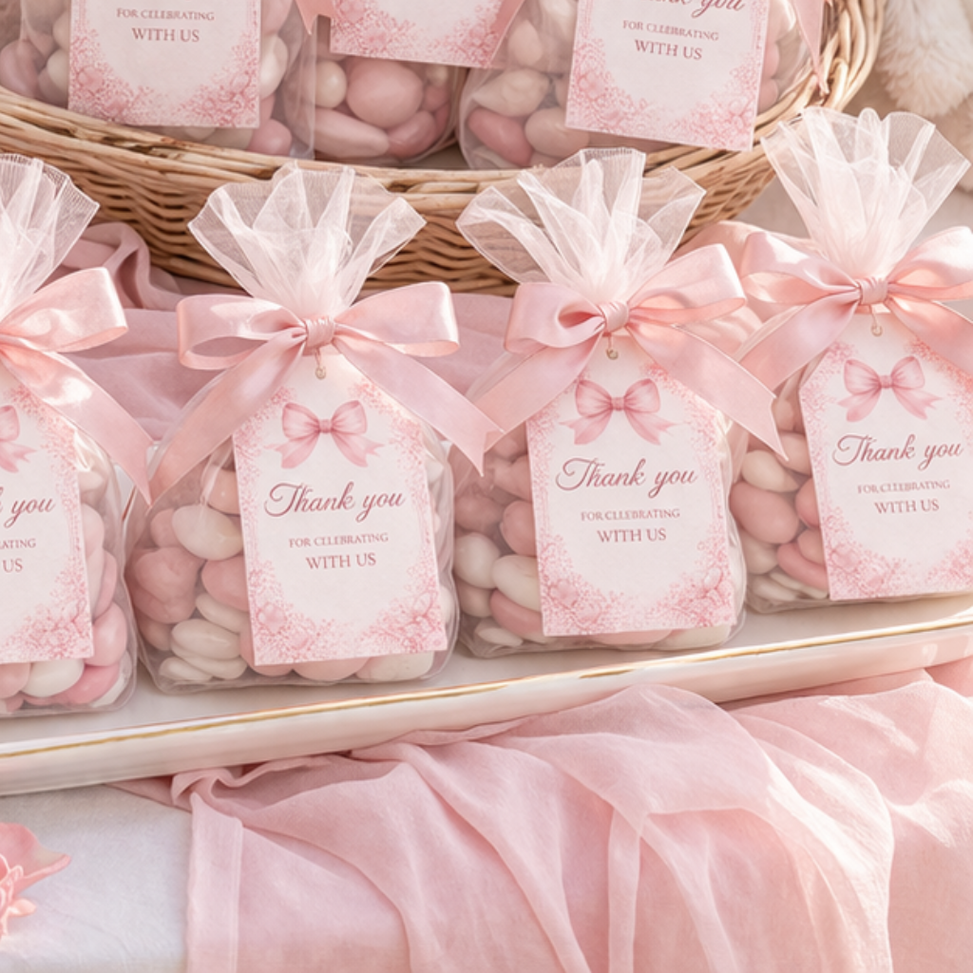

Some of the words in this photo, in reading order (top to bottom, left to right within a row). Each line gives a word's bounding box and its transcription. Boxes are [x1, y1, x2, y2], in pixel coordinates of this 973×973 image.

[116, 8, 139, 18] FOR
[622, 20, 644, 31] FOR
[131, 28, 175, 42] WITH
[180, 29, 200, 42] US
[634, 39, 678, 57] WITH
[682, 46, 703, 61] US
[831, 433, 916, 467] Thank
[917, 443, 964, 471] you
[555, 457, 646, 491] Thank
[647, 469, 697, 499] you
[264, 481, 355, 518] Thank
[355, 491, 407, 523] you
[874, 499, 916, 514] WITH
[920, 498, 940, 512] US
[3, 497, 56, 528] you
[581, 511, 604, 521] FOR
[288, 538, 312, 548] FOR
[597, 529, 642, 543] WITH
[646, 527, 667, 542] US
[2, 558, 23, 573] US
[305, 554, 351, 570] WITH
[356, 552, 377, 567] US
